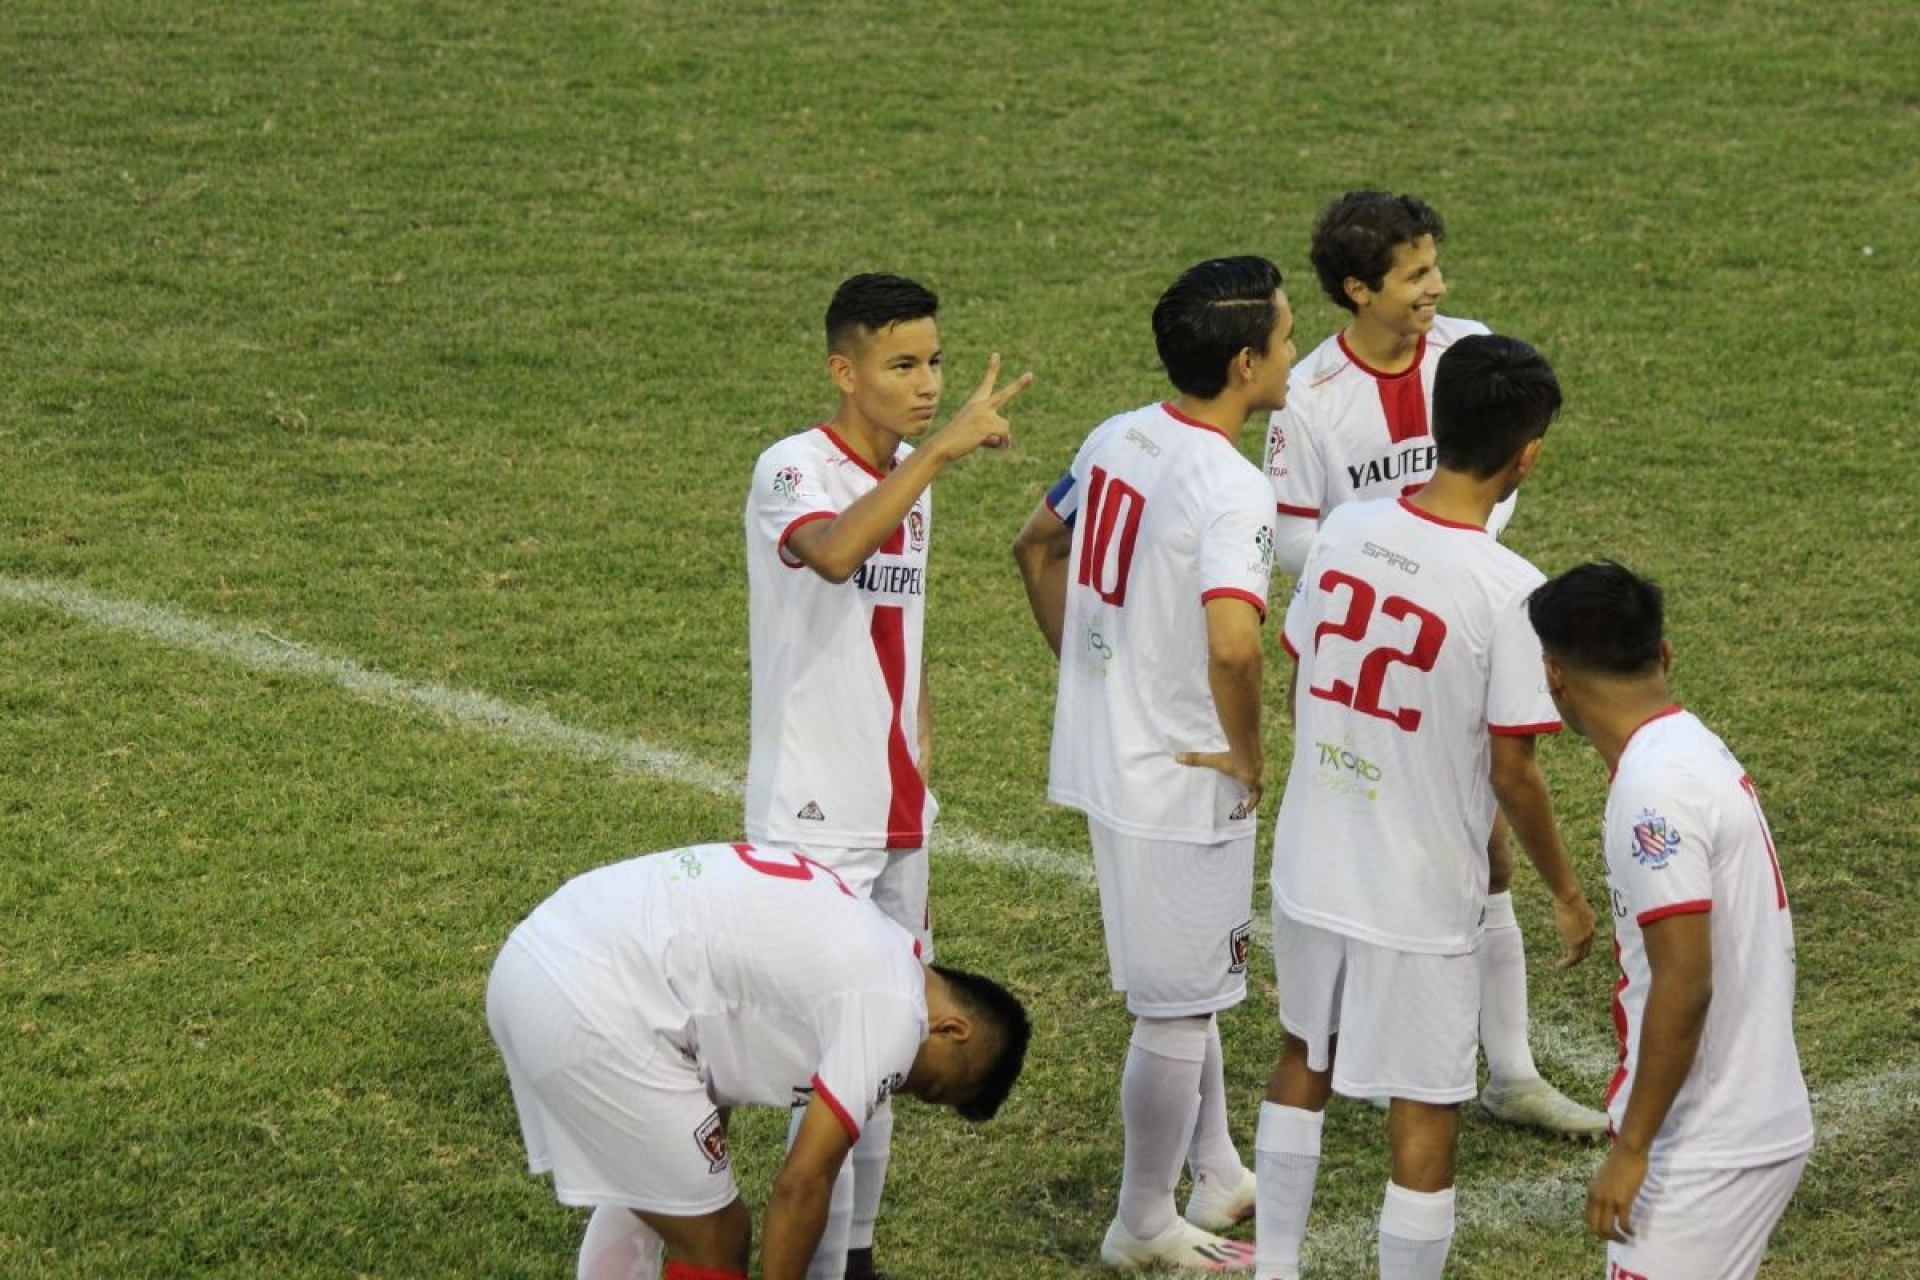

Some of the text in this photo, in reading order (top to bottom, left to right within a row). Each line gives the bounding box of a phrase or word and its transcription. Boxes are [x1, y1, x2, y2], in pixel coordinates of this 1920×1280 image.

[1347, 446, 1438, 489] YAUTEP
[1078, 464, 1147, 608] 10
[852, 564, 923, 595] AUTEPEC
[1361, 541, 1421, 576] SPIRO
[1310, 569, 1448, 733] 22
